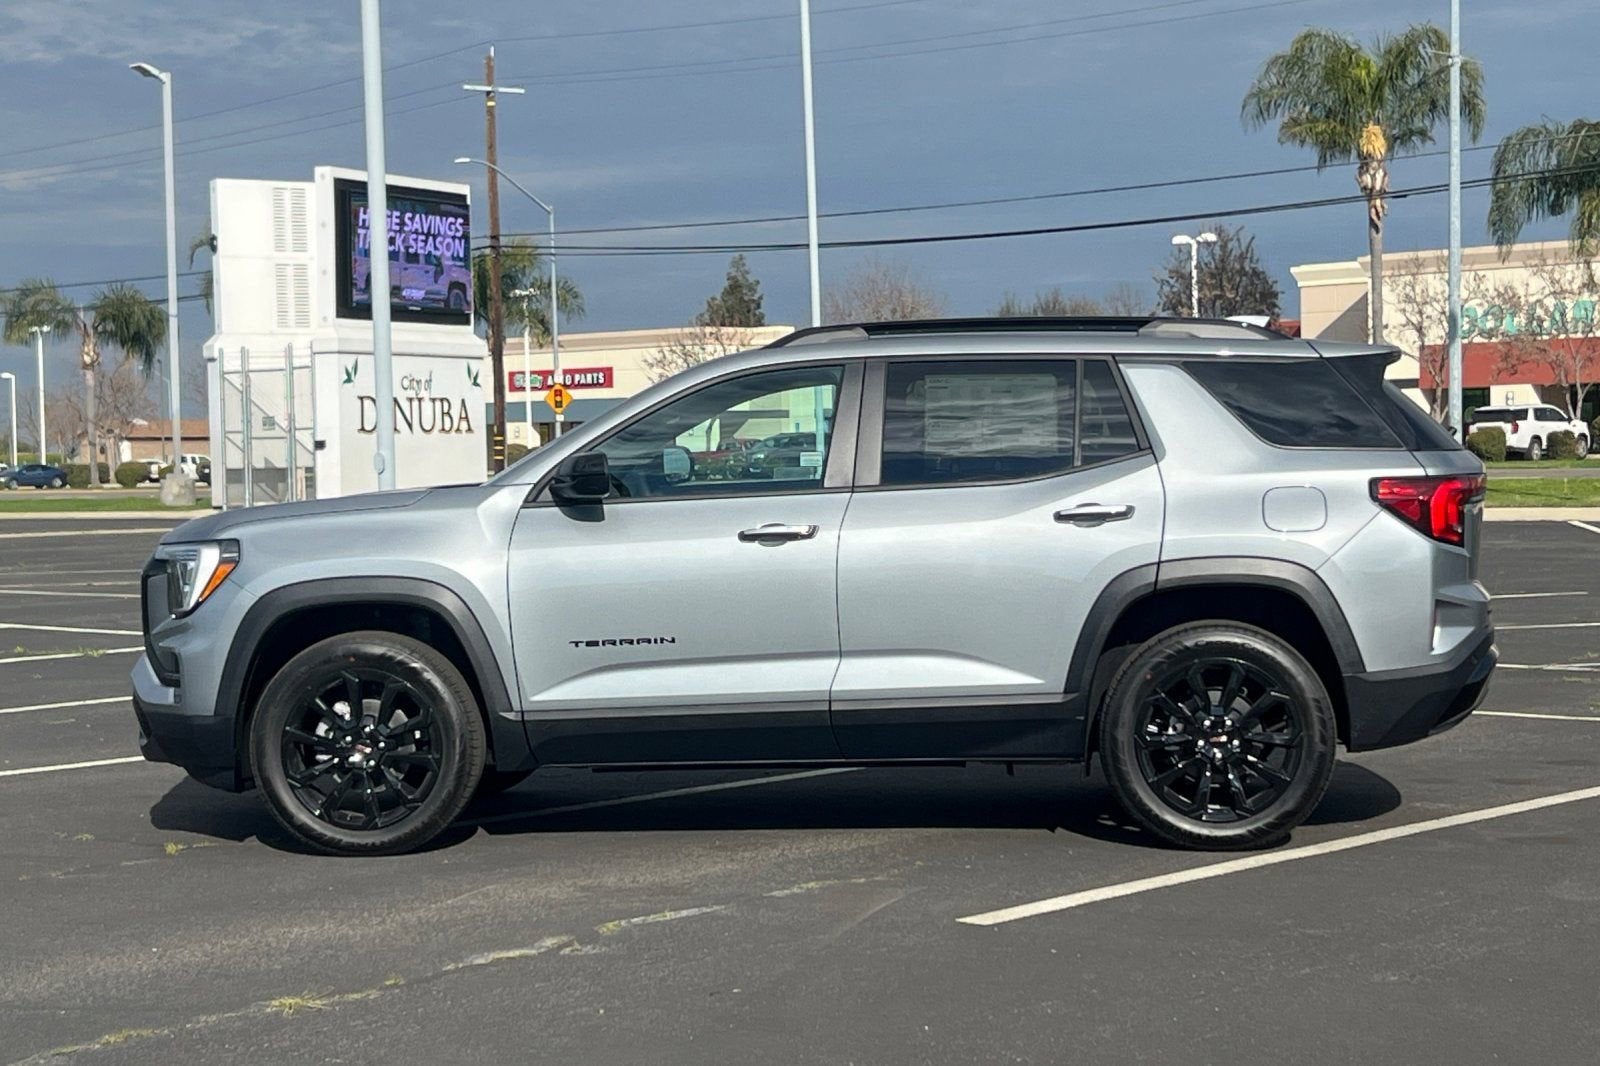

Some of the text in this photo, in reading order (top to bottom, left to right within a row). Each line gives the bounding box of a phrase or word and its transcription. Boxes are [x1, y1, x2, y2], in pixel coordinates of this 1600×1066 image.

[404, 212, 464, 237] SAVINGS
[357, 228, 465, 258] TCK SEASON
[401, 370, 433, 397] City of
[547, 374, 571, 387] AO
[574, 372, 605, 386] PARTS
[357, 396, 474, 434] DNUBA
[568, 637, 676, 648] TERRAIN
